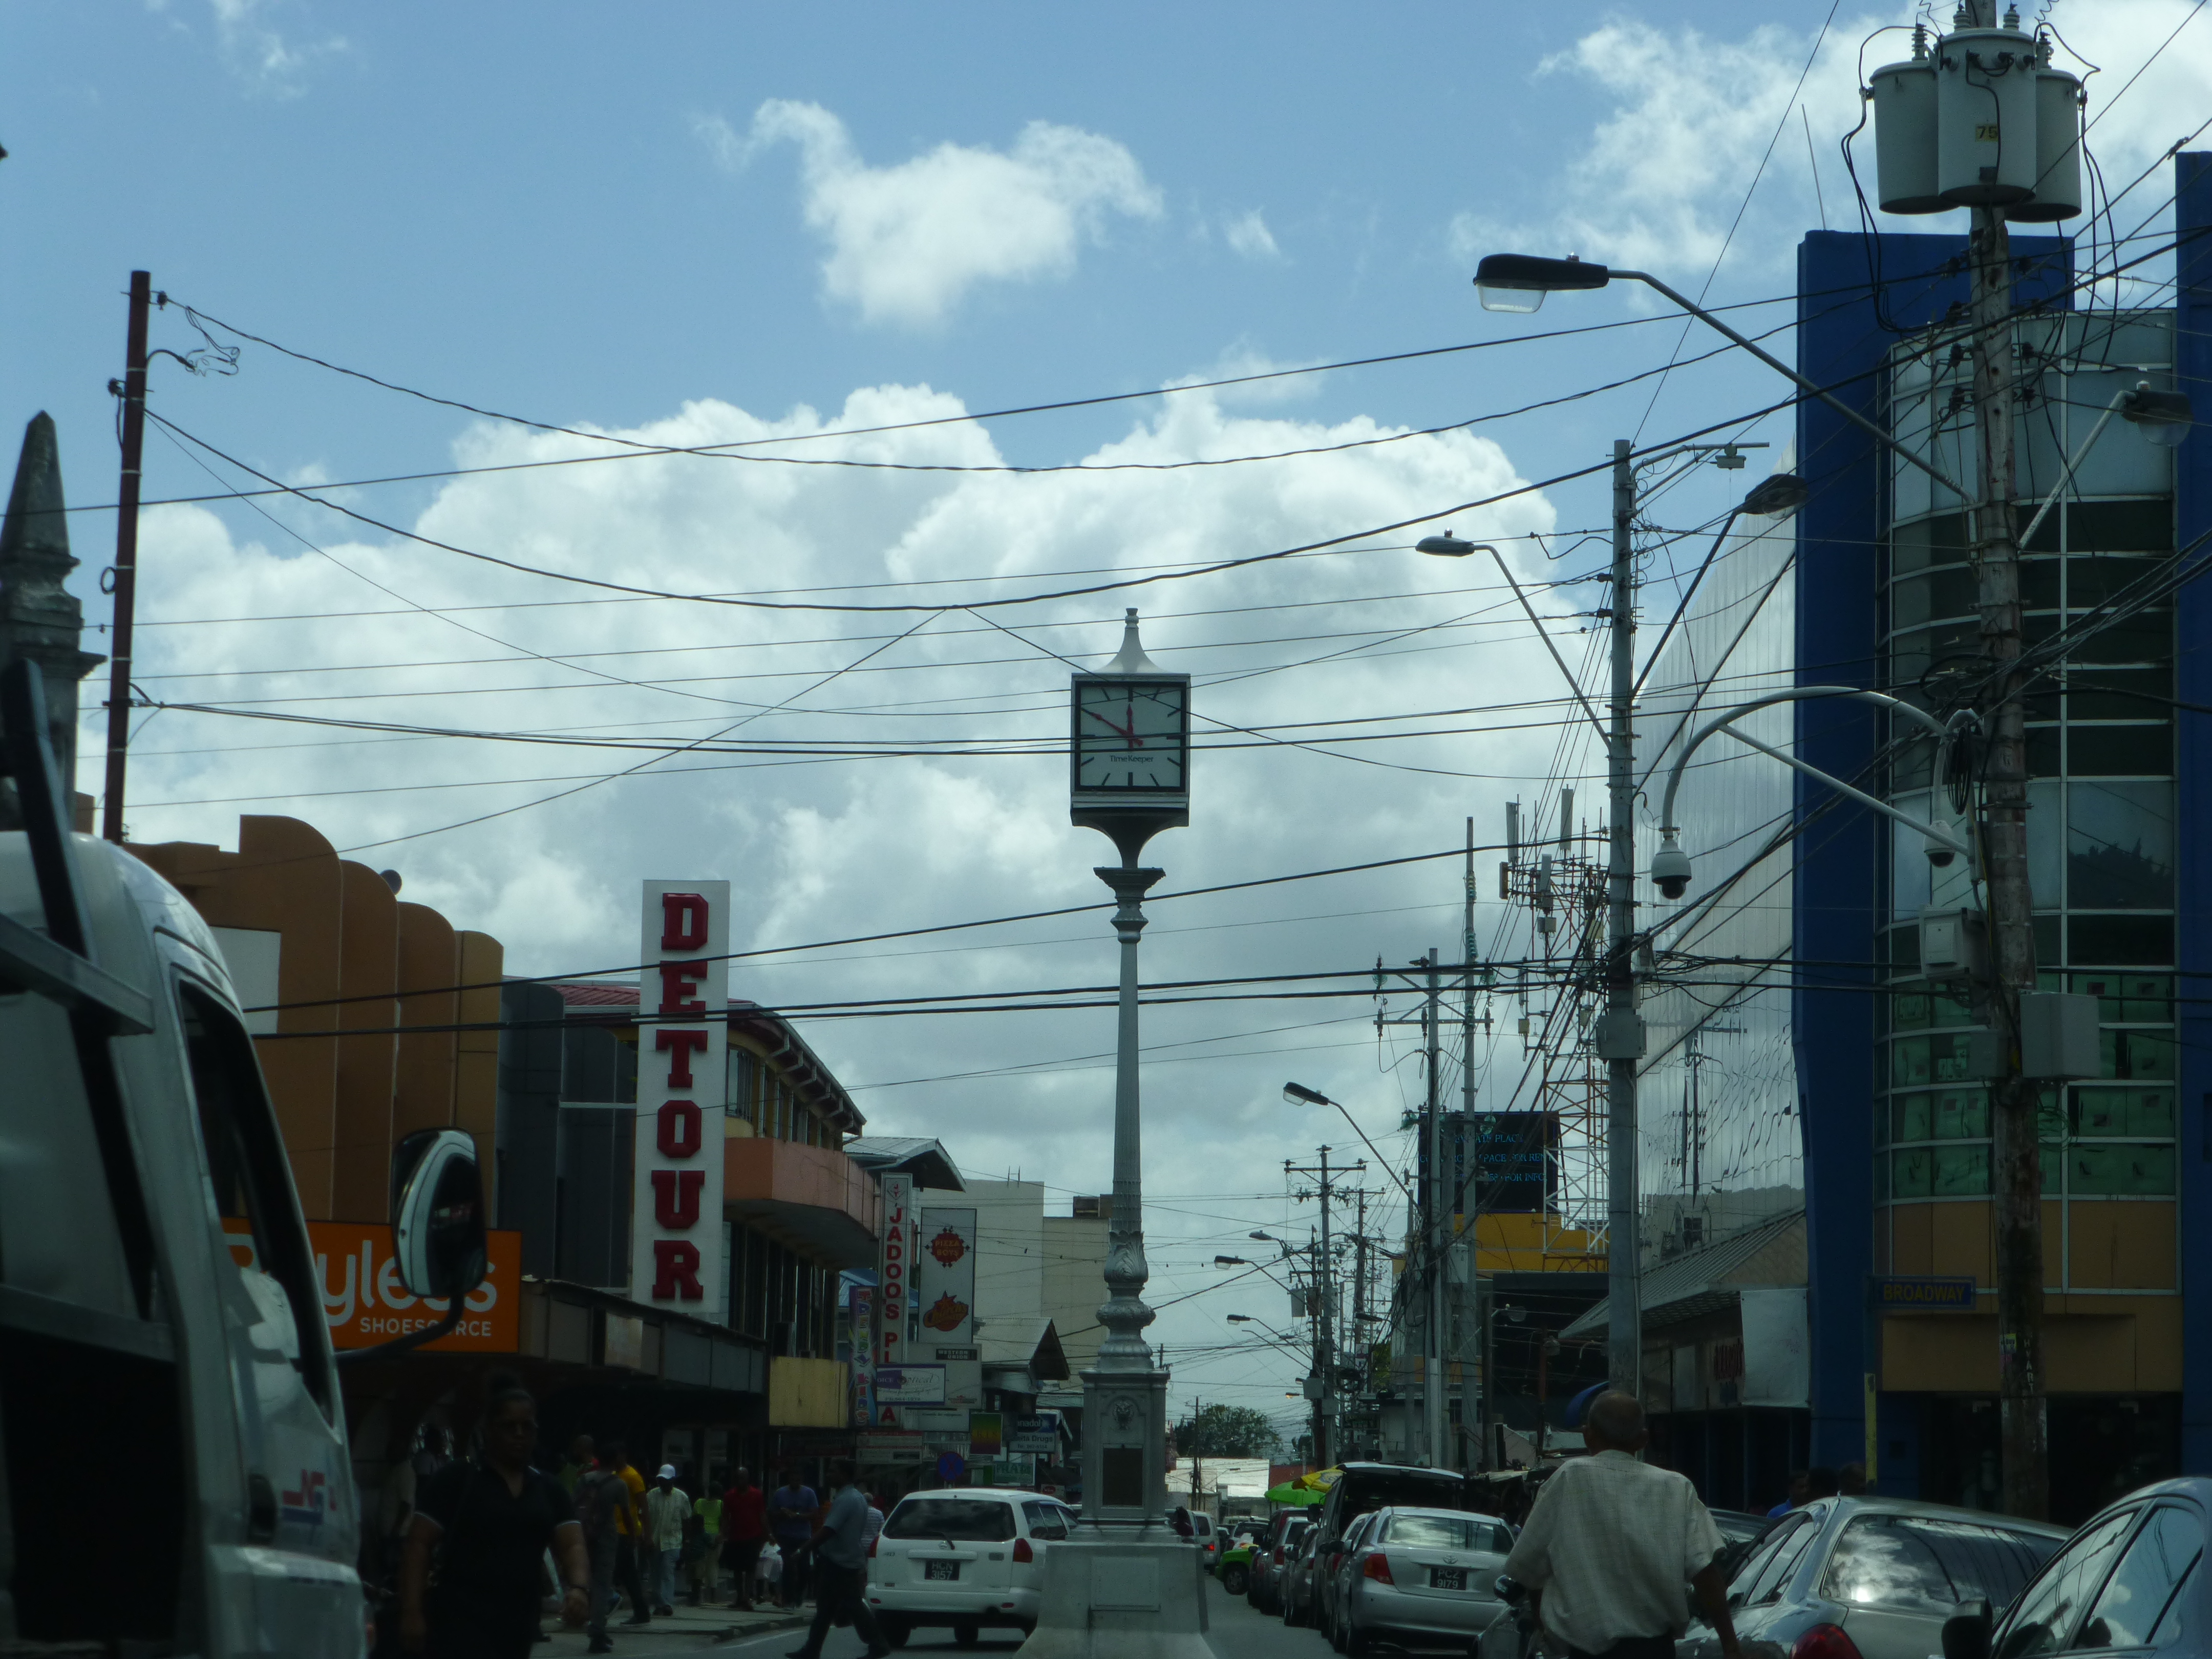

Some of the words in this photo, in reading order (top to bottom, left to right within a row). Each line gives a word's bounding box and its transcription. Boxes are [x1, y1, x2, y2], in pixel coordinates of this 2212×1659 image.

[1979, 126, 1997, 140] 75
[651, 892, 709, 1300] DETOUR
[224, 1233, 497, 1326] Pyles
[1883, 1284, 1965, 1302] BROADWAY
[359, 1316, 492, 1336] SHOESRCE
[881, 1332, 898, 1422] PIA
[1032, 1435, 1053, 1443] Drugs
[931, 1570, 952, 1580] 3157
[1437, 1579, 1458, 1589] 9179
